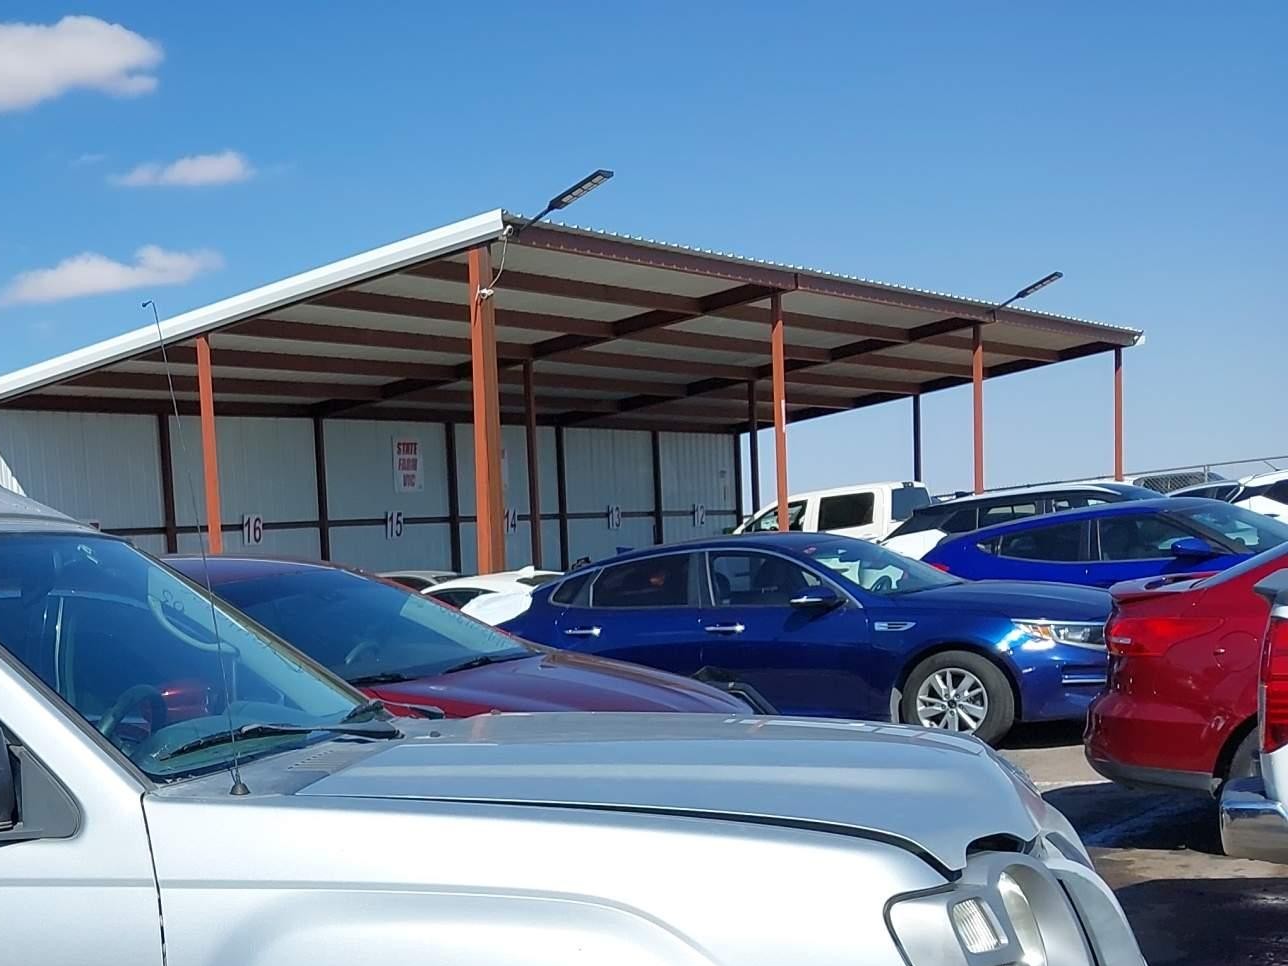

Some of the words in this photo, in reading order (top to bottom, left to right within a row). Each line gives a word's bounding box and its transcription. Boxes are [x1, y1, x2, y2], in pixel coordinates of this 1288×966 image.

[397, 442, 418, 455] STATE
[388, 512, 403, 538] 15
[505, 508, 516, 533] 14
[610, 506, 621, 528] 13
[695, 504, 705, 525] 12
[245, 515, 263, 544] 16
